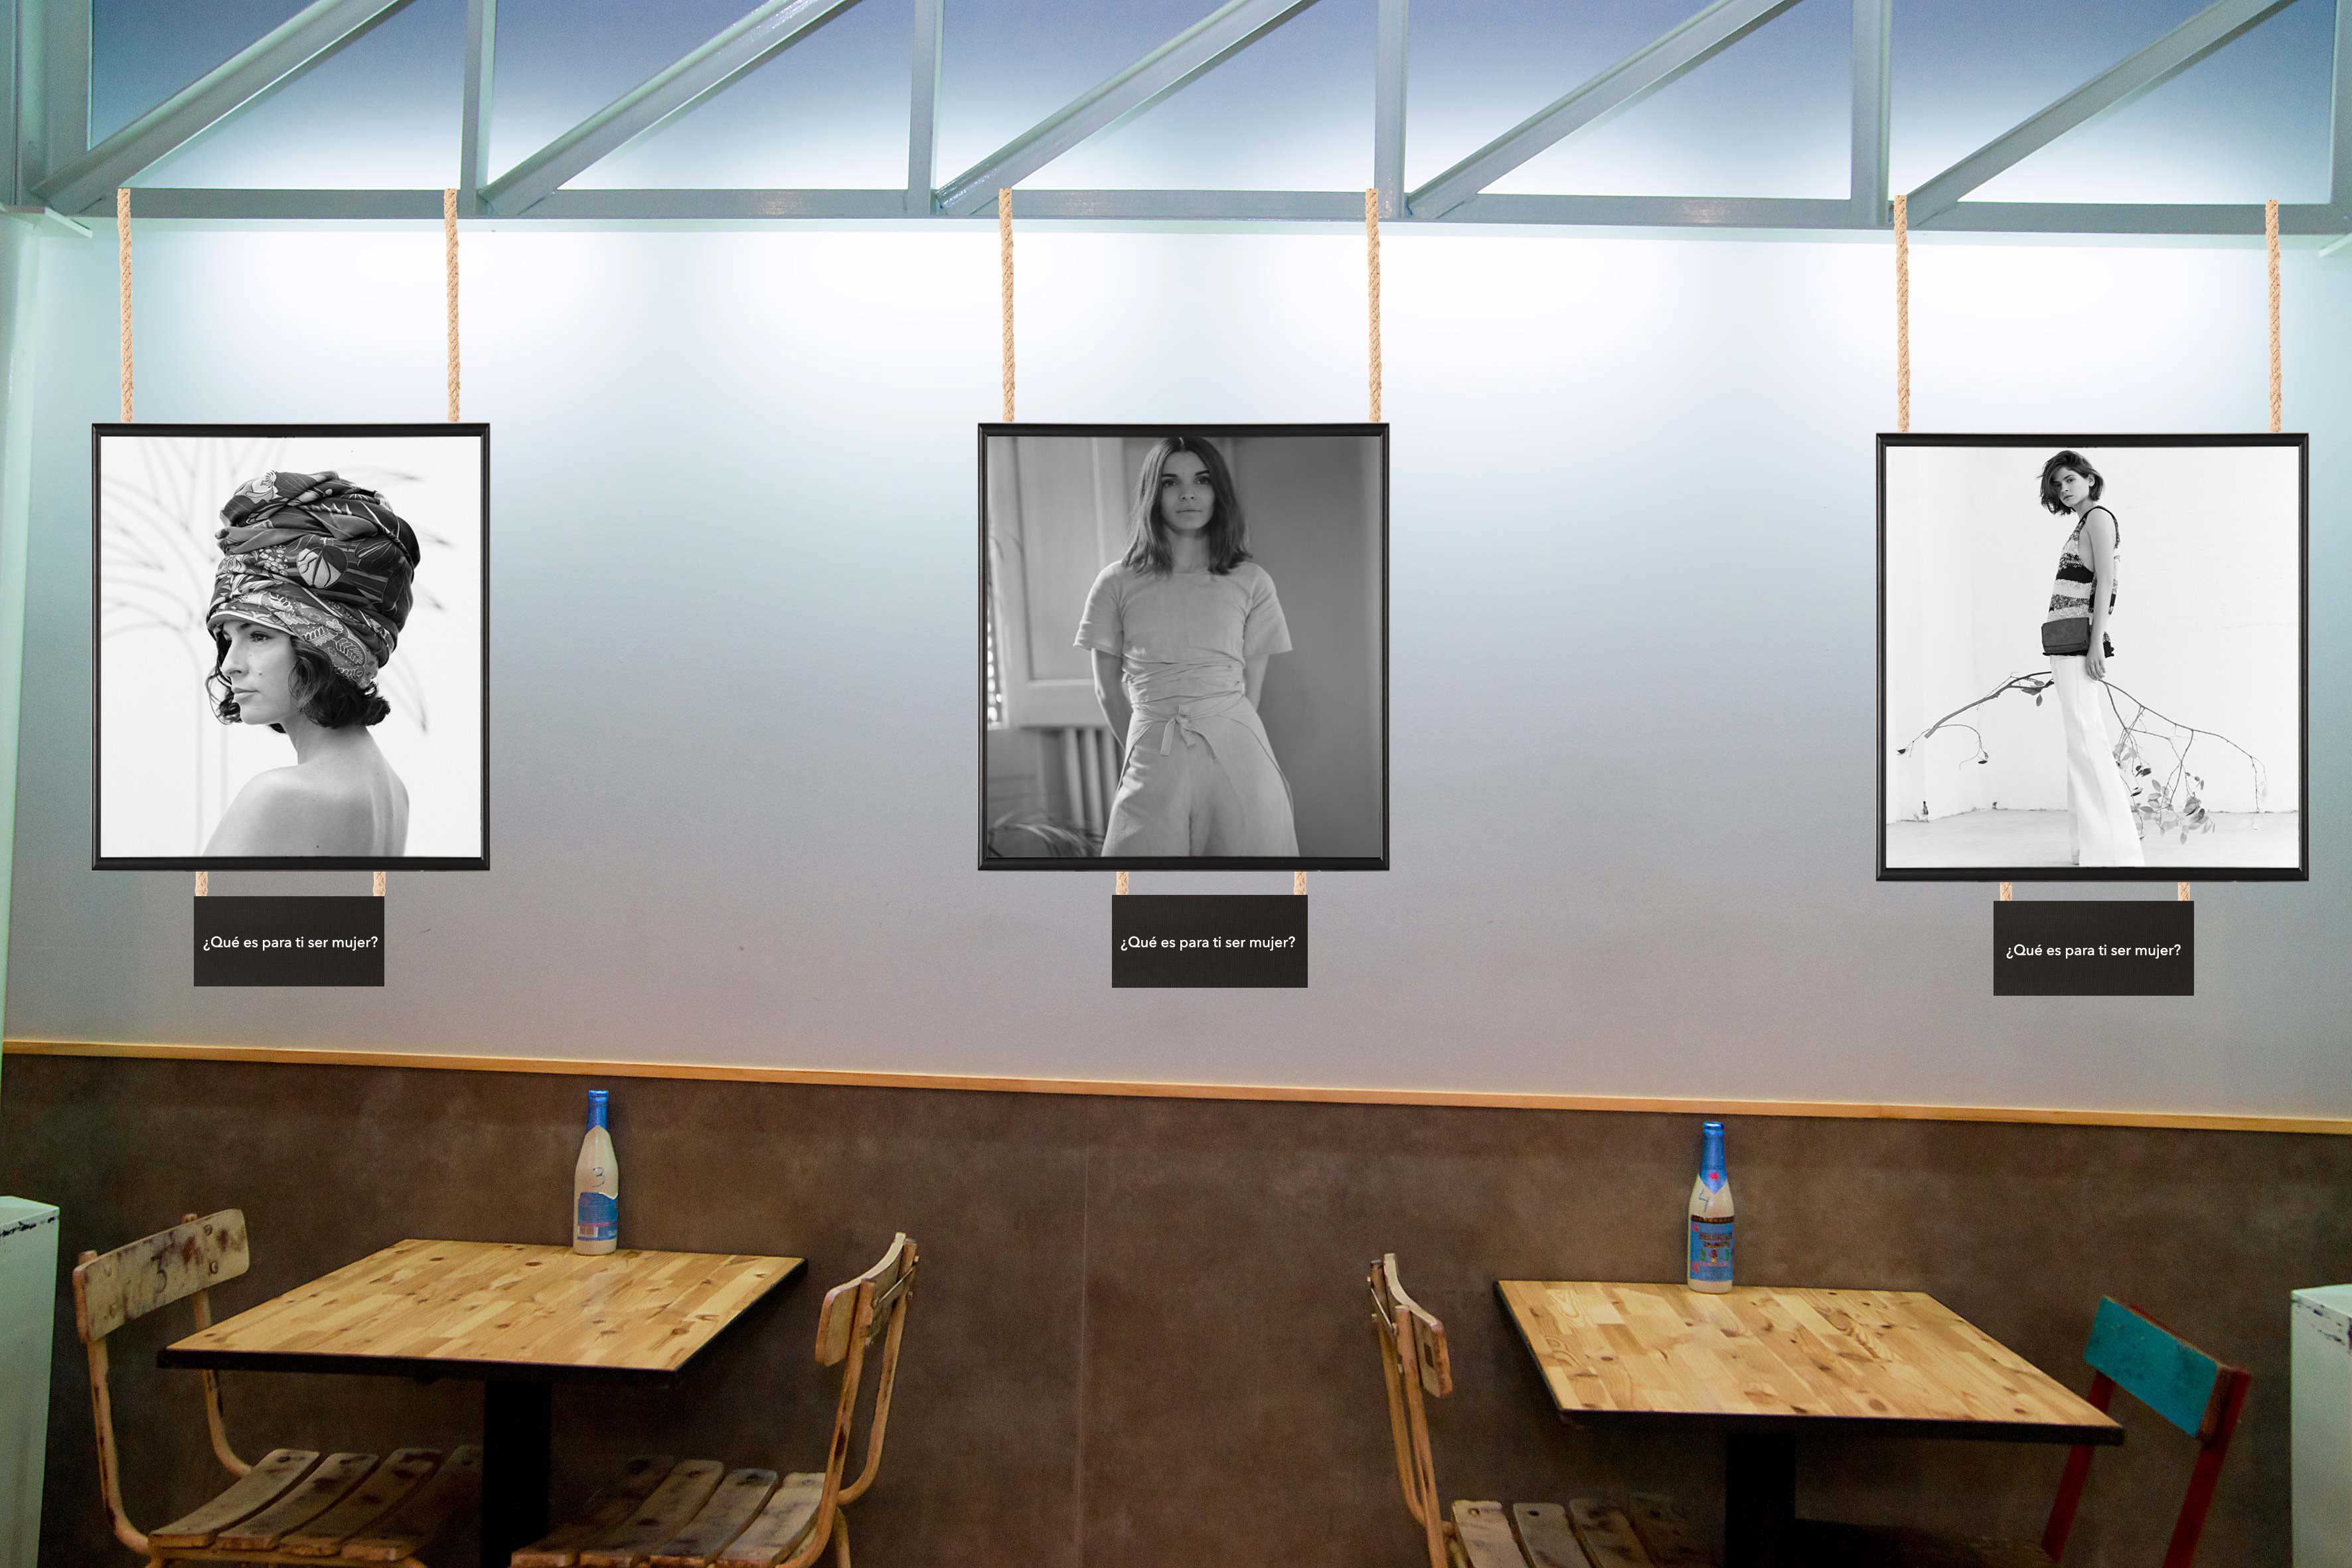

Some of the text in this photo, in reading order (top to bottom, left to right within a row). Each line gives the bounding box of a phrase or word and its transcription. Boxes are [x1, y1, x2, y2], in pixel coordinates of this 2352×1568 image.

[202, 935, 378, 951] ¿Qué es para ti ser mujer?
[1120, 935, 1296, 951] ¿Qué es para ti ser mujer?
[2006, 943, 2181, 959] ¿Qué es para ti ser mujer?
[592, 1166, 605, 1188] 3
[1698, 1189, 1710, 1212] 4
